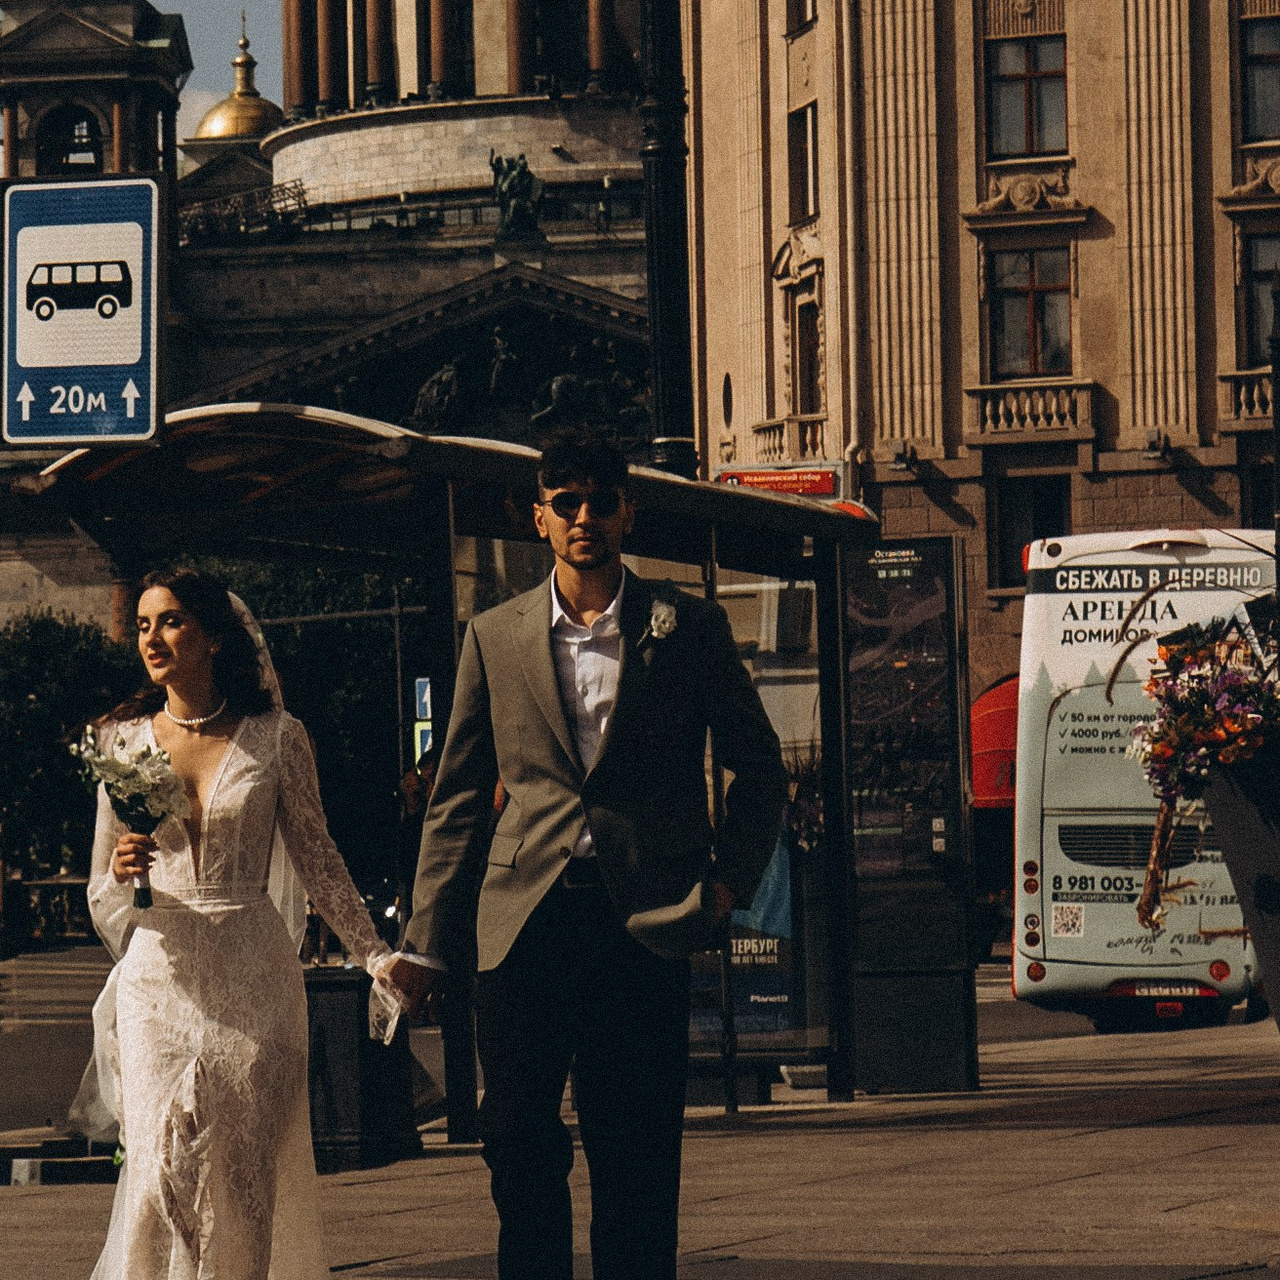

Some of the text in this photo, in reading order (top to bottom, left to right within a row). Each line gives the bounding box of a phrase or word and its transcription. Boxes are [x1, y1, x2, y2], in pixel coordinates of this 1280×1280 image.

[1055, 567, 1262, 591] СБЕЖАТЬ В ДЕРЕВНЮ
[1062, 599, 1179, 624] АРЕНДА
[1070, 712, 1085, 723] 50
[1103, 714, 1115, 723] от
[1070, 728, 1099, 738] 4000
[1070, 746, 1107, 754] можно
[1052, 875, 1063, 891] 8
[1068, 875, 1096, 891] 981
